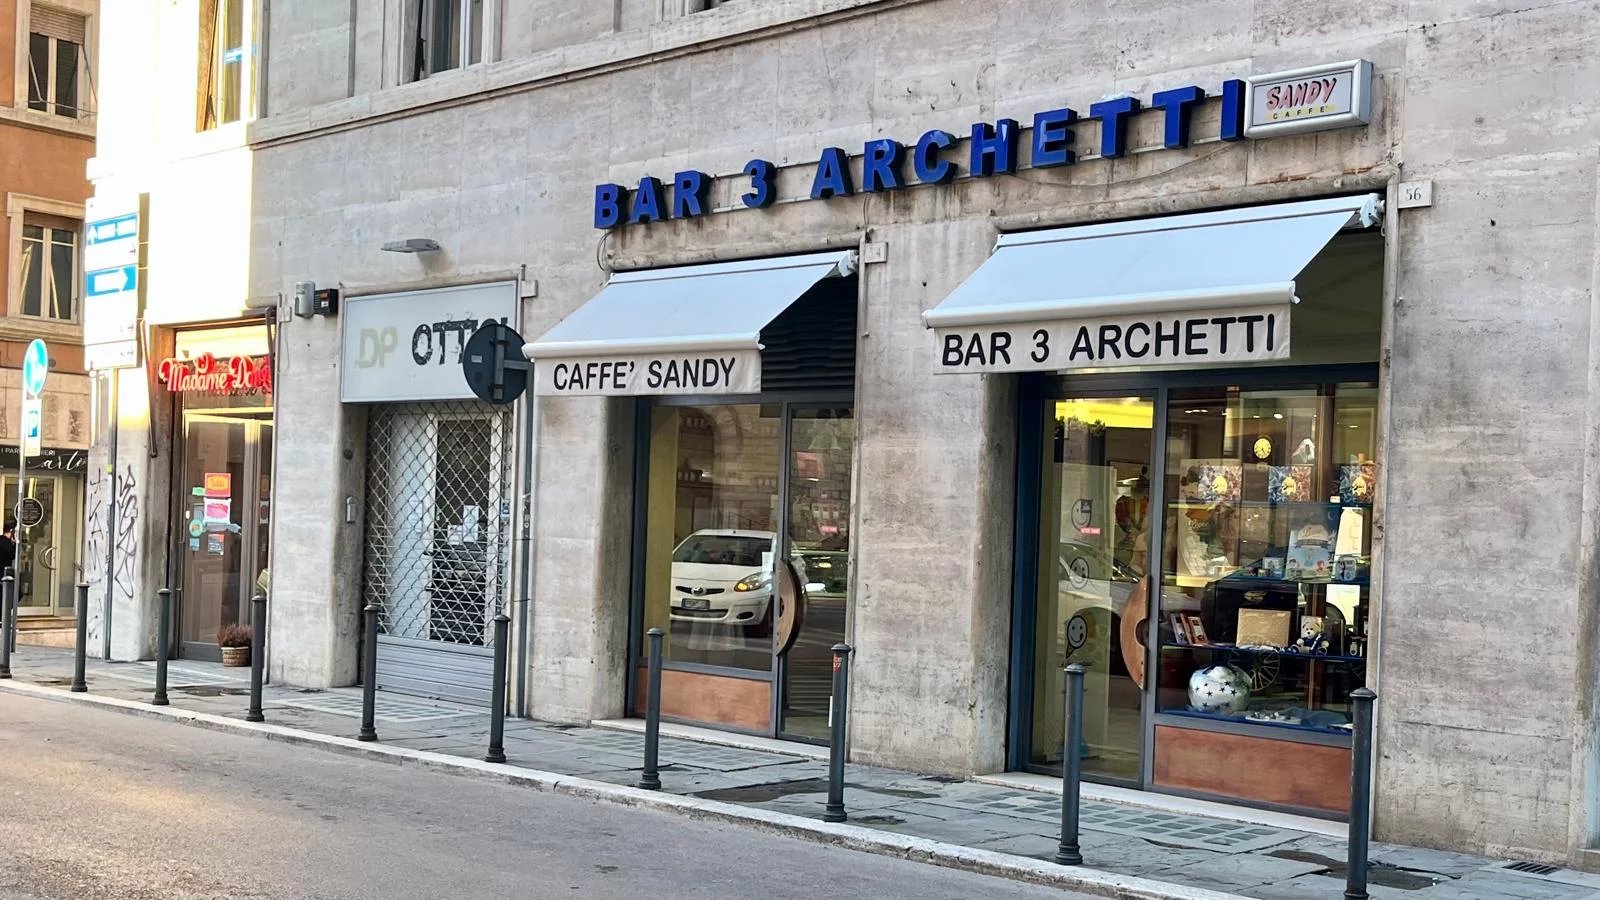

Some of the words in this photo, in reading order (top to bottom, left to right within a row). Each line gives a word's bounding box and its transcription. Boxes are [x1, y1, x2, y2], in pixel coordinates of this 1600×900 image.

[1266, 78, 1337, 110] SANDY
[594, 170, 710, 229] BAR
[741, 159, 777, 208] 3
[809, 79, 1247, 200] ARCHETTI
[1405, 187, 1422, 201] 56
[942, 332, 1012, 366] BAR
[1031, 329, 1050, 363] 3
[1069, 313, 1276, 362] ARCHETTI
[553, 361, 635, 391] CAFFE'
[647, 357, 736, 389] SANDY
